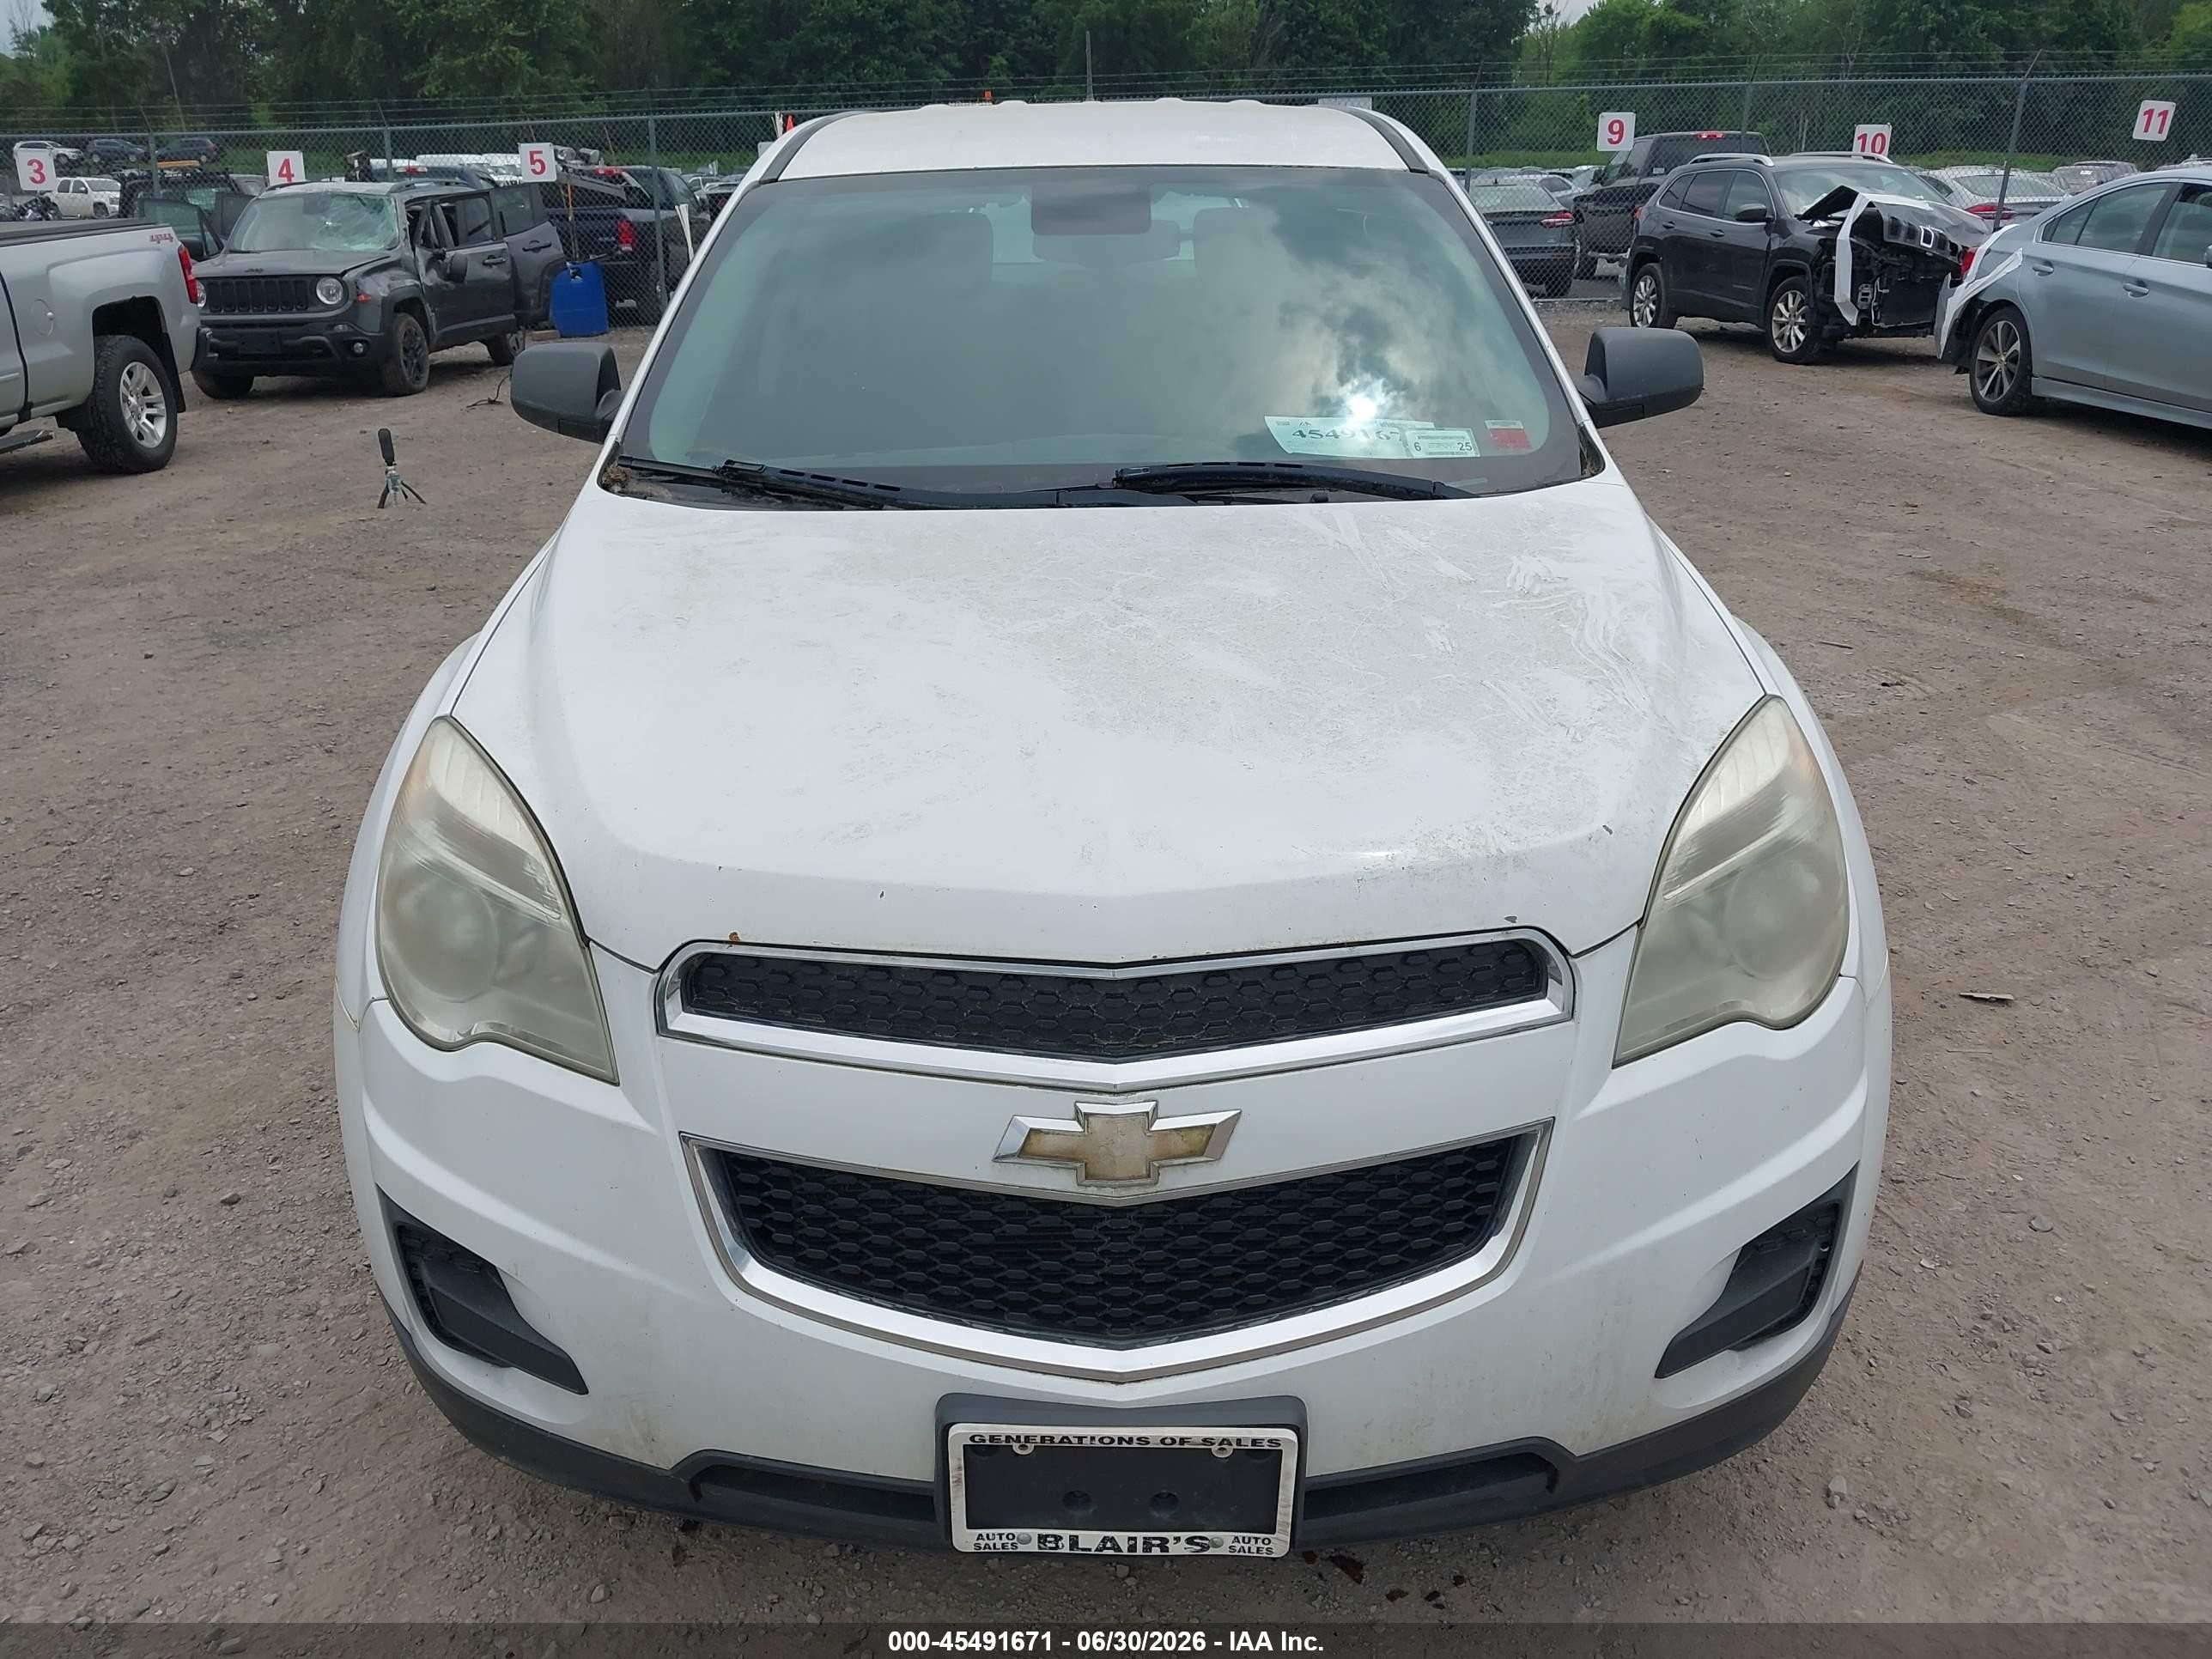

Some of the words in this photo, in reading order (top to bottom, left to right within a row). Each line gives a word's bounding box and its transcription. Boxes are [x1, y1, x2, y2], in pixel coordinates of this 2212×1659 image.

[1607, 118, 1625, 145] 9
[2142, 108, 2169, 135] 11
[1856, 132, 1887, 155] 10
[27, 158, 46, 185] 3
[277, 157, 295, 183] 4
[529, 149, 546, 176] 5
[1413, 441, 1422, 452] 6
[1457, 441, 1473, 452] 25
[969, 1434, 1151, 1447] GENERATIONS
[1159, 1436, 1193, 1447] OF
[1200, 1437, 1282, 1449] SALES
[973, 1541, 1019, 1552] SALES
[975, 1532, 1017, 1542] AUTO
[1036, 1533, 1212, 1553] BLAIR'S
[1231, 1535, 1273, 1546] AUTO
[1228, 1545, 1275, 1556] SALES
